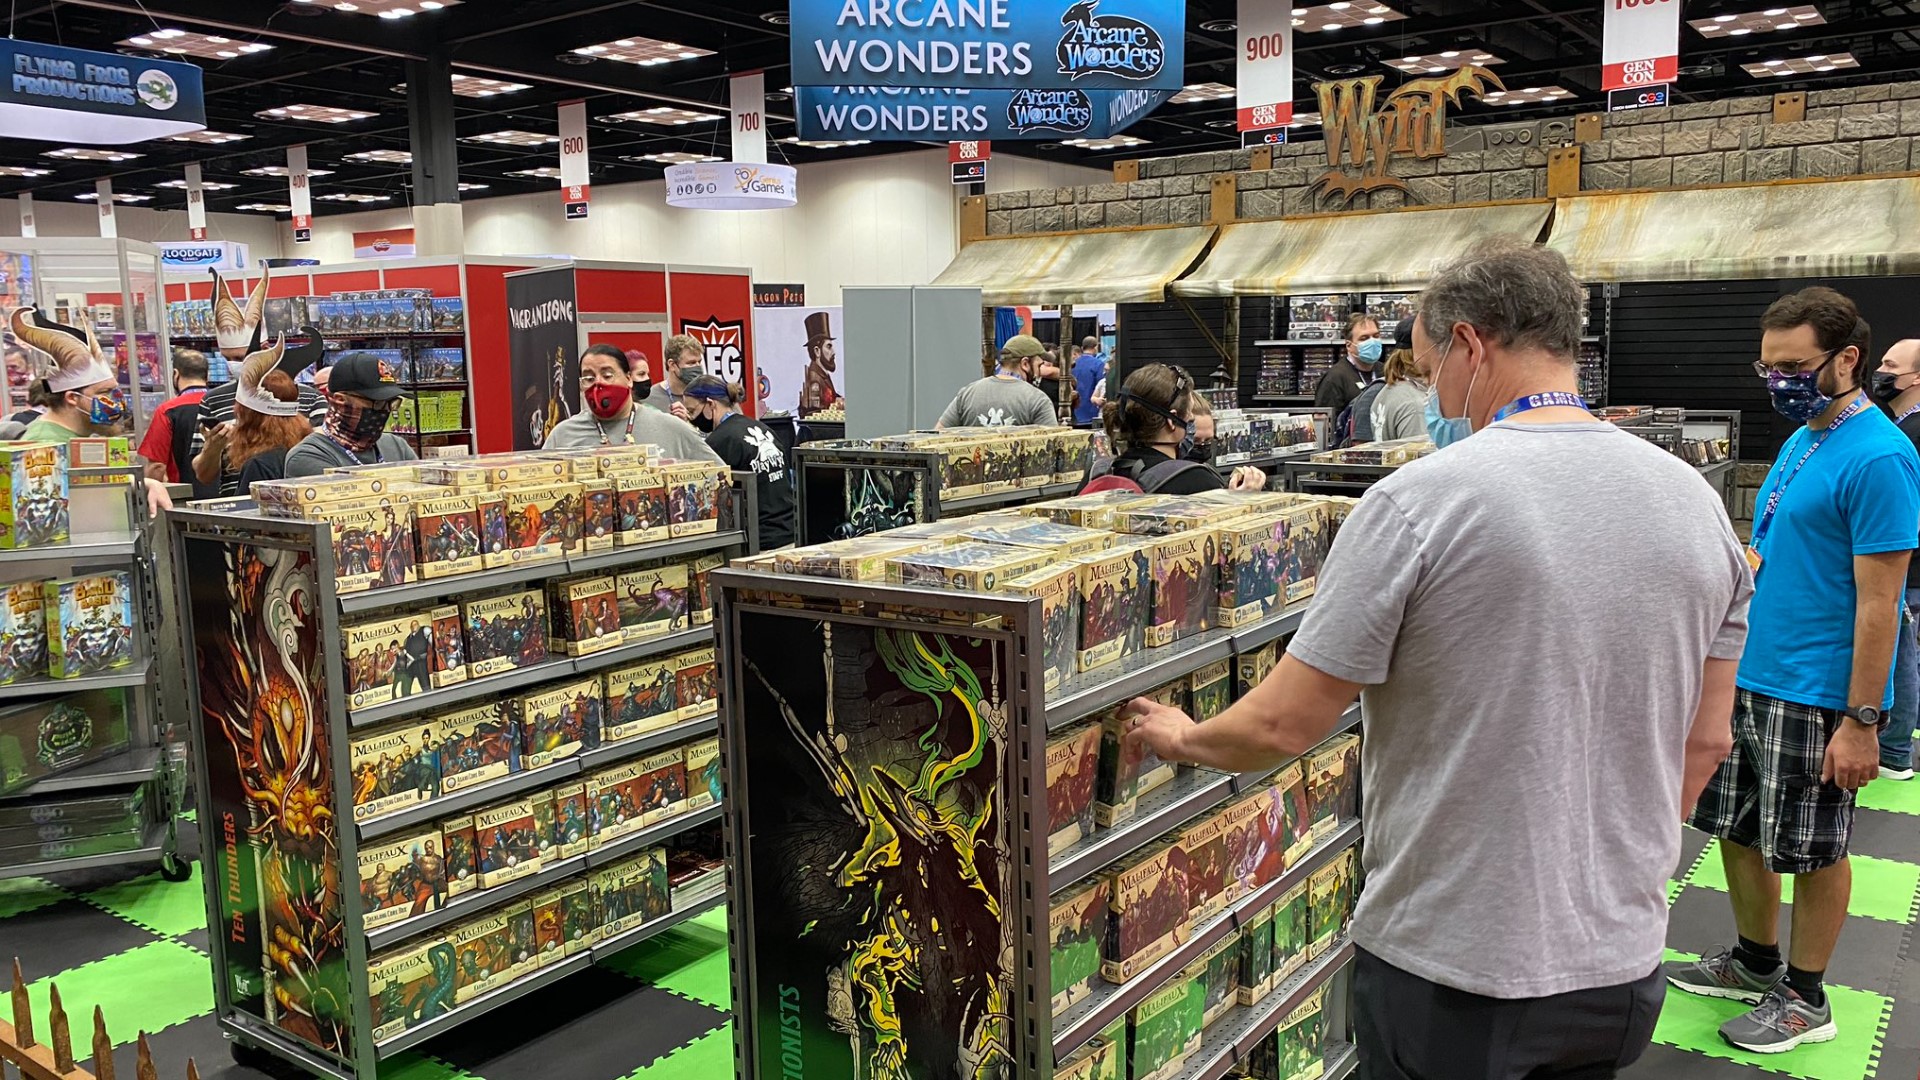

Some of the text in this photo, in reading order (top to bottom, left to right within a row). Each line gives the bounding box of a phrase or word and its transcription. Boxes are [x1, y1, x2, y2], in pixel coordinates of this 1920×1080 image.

[836, 0, 1010, 28] ARCANE
[1069, 18, 1148, 46] Arcane
[814, 39, 1033, 76] WONDERS
[1064, 43, 1161, 72] Wonders
[1246, 33, 1283, 61] 900
[13, 53, 129, 86] FLYING FROG
[1622, 70, 1655, 84] CON
[1623, 59, 1656, 74] GEN
[12, 73, 136, 106] PRODUCTIONS
[1017, 89, 1079, 106] Arcane
[816, 104, 988, 132] WONDERS
[1013, 105, 1090, 126] Wonders
[1252, 104, 1277, 117] GEN
[1252, 114, 1276, 126] CON
[738, 112, 759, 132] 700
[1310, 66, 1480, 195] Wyrd
[564, 136, 583, 155] 600
[960, 141, 978, 151] GEN
[960, 150, 978, 159] CON
[292, 174, 306, 188] 400
[752, 180, 785, 194] Games
[161, 248, 220, 259] FLOODGATE
[509, 299, 573, 329] VAGRANTSONG
[620, 474, 661, 489] MALIFAUX
[670, 470, 709, 483] MALIFAUX
[422, 498, 473, 515] MALIFAUX
[512, 489, 559, 505] MALIFAUX
[322, 510, 377, 524] MALIFAUX
[1238, 525, 1272, 547] MALIFAUX
[1157, 538, 1197, 562] MALIFAUX
[619, 571, 662, 588] MALIFAUX
[1089, 557, 1132, 581] MALIFAUX
[573, 580, 612, 597] MALIFAUX
[470, 597, 517, 617] MALIFAUX
[352, 623, 402, 644] MALIFAUX
[678, 650, 715, 669] MALIFAUX
[611, 667, 653, 686] MALIFAUX
[1195, 664, 1227, 686] MALIFAUX
[528, 690, 572, 712] MALIFAUX
[441, 709, 491, 731] MALIFAUX
[354, 733, 409, 758] MALIFAUX
[641, 751, 681, 772] MALIFAUX
[1312, 749, 1343, 774] MALIFAUX
[479, 804, 529, 827] MALIFAUX
[1223, 797, 1261, 828] MALIFAUX
[223, 811, 245, 943] TEN THUNDERS
[602, 861, 643, 884] MALIFAUX
[1120, 857, 1164, 894] MALIFAUX
[456, 916, 504, 943] MALIFAUX
[371, 953, 426, 983] MALIFAUX
[1140, 984, 1185, 1020] MALIFAUX
[1281, 997, 1319, 1028] MALIFAUX
